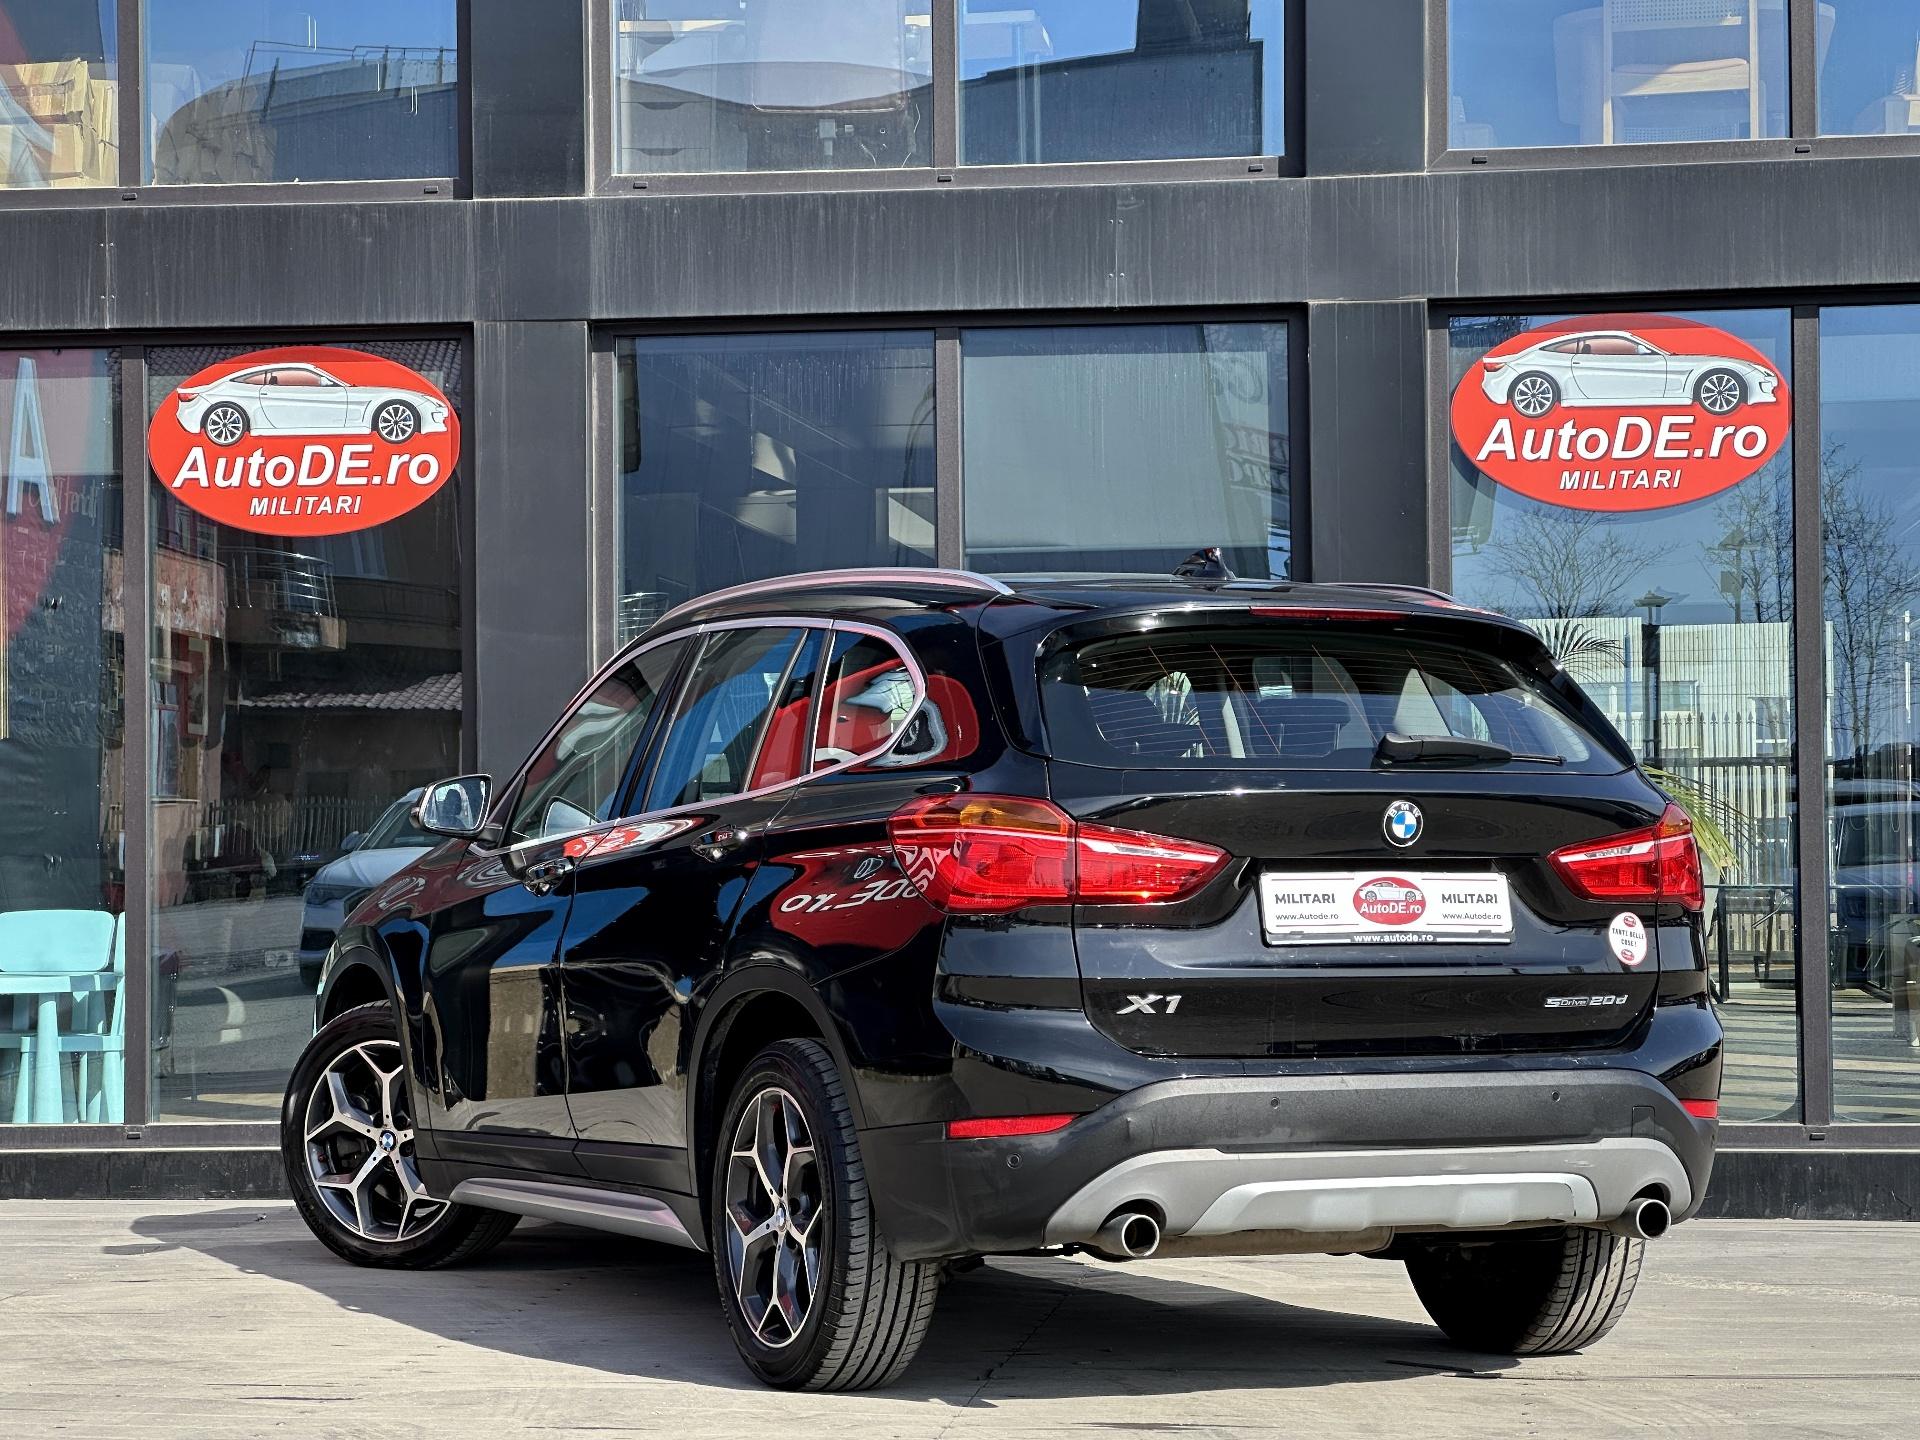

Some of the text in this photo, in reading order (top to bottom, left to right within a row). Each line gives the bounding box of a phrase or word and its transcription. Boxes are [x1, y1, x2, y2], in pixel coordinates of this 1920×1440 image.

[1476, 415, 1768, 462] AutoDE.ro
[171, 444, 440, 488] AutoDE.ro
[1559, 469, 1682, 491] MILITARI
[249, 495, 362, 516] MILITARI
[1275, 893, 1336, 904] MILITARI
[1441, 893, 1498, 904] MILITARI
[1360, 902, 1422, 914] AutoDE.ro
[1275, 912, 1339, 920] www.Autode.ro
[1442, 912, 1502, 920] www.Autode.ro
[1353, 933, 1434, 943] www.autode.ro
[1116, 994, 1182, 1015] X1
